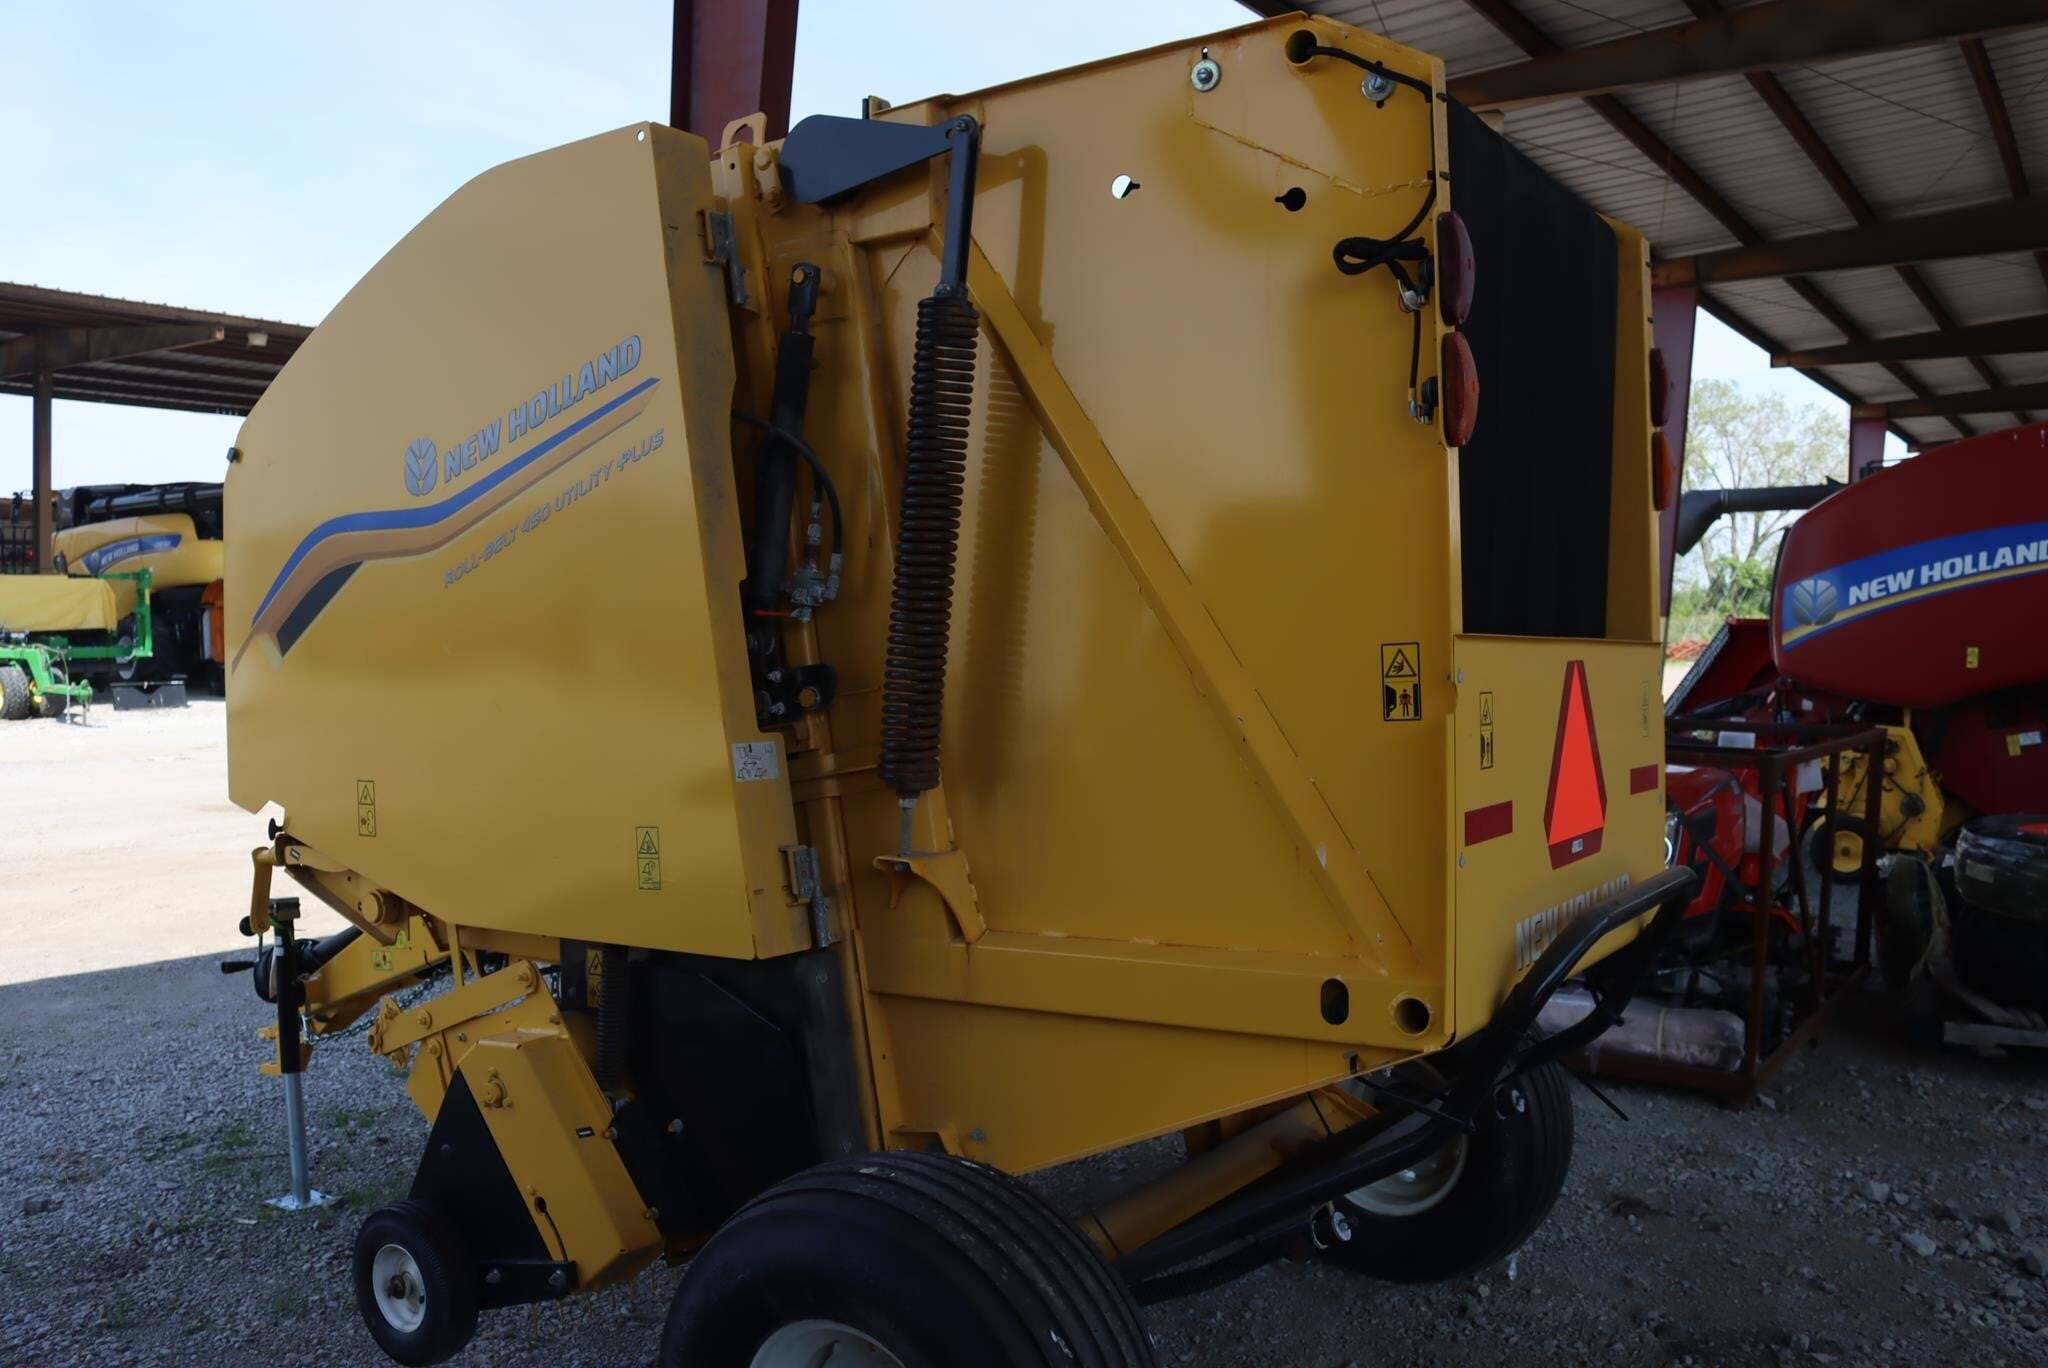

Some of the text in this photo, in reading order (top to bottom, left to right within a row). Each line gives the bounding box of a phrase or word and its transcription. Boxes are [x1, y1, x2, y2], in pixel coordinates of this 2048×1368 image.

[444, 335, 641, 483] NEW HOLLAND
[444, 428, 665, 587] ROLL-BELT 450 UTILITY PLUS
[1848, 568, 1916, 606] NEW
